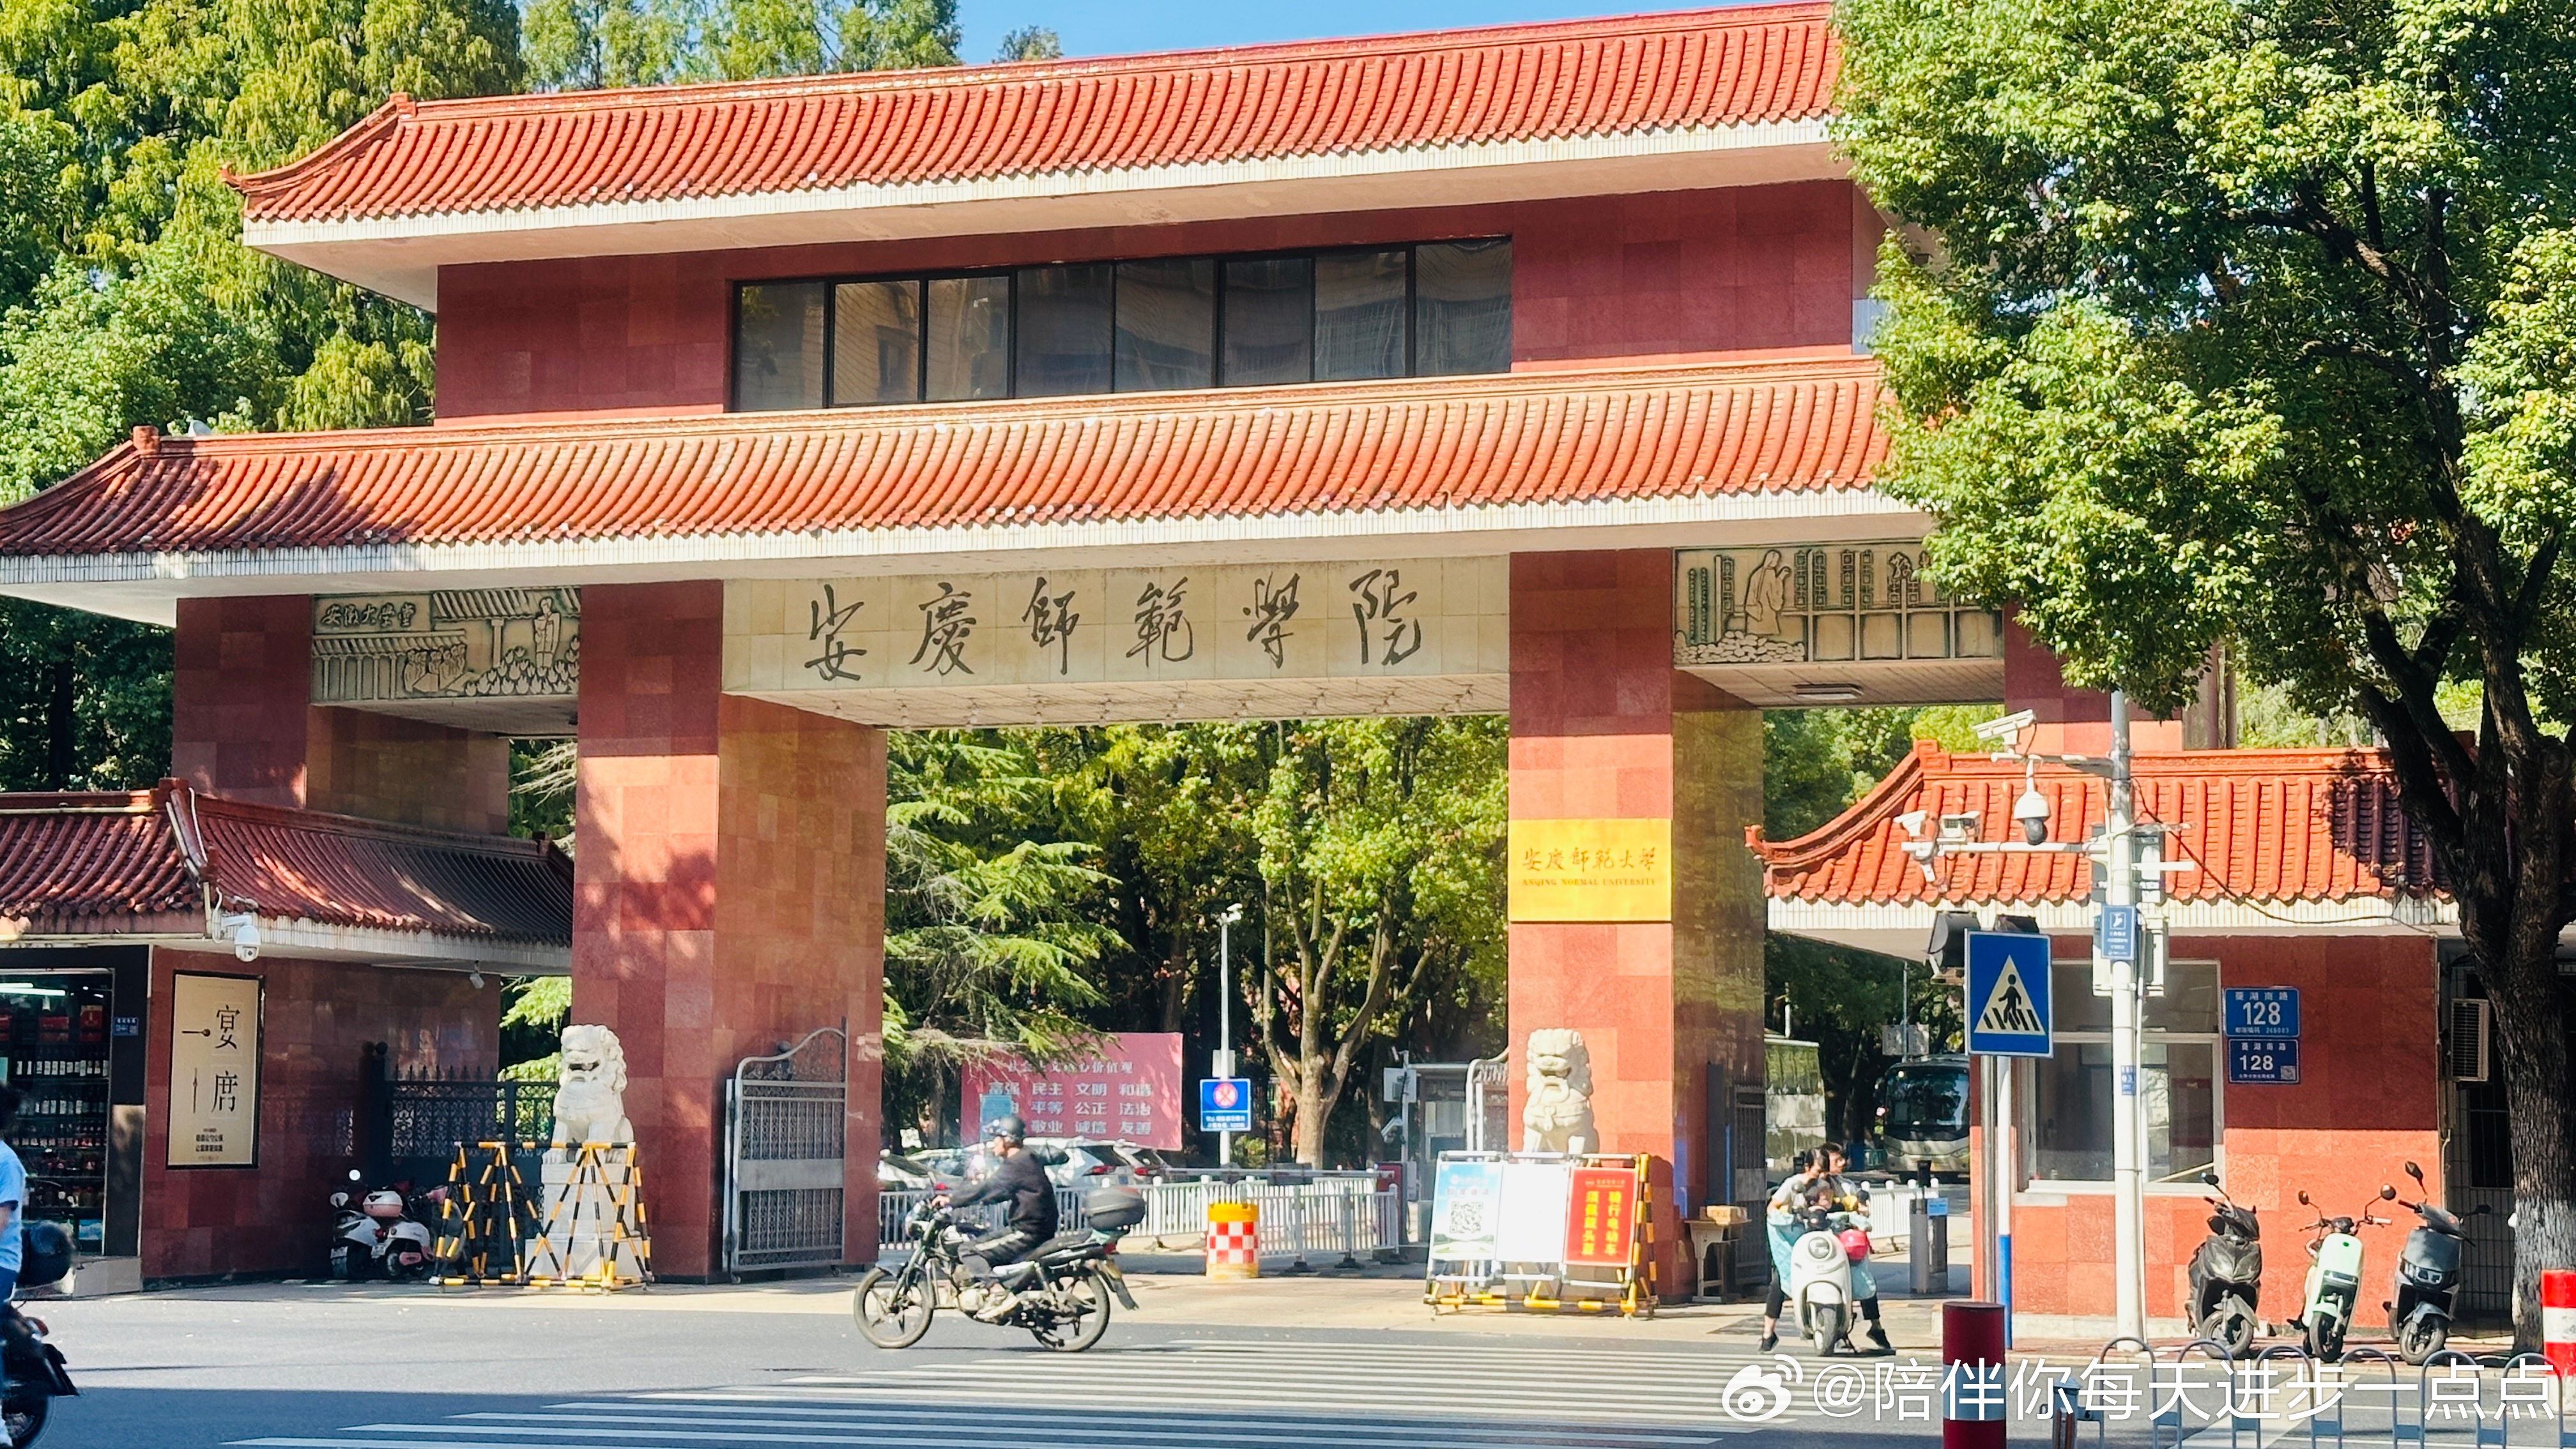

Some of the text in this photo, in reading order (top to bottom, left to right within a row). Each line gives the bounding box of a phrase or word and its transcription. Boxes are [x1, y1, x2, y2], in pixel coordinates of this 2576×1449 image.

[1522, 878, 1557, 887] ANQING
[1603, 878, 1655, 886] UNIVERSITY
[2242, 1002, 2281, 1025] 128
[2239, 1055, 2274, 1070] 128
[988, 1082, 1152, 1097] 富强 民主 文明 和谐
[1031, 1102, 1064, 1115] 平等
[1075, 1102, 1107, 1115] 公正
[1119, 1102, 1151, 1116] 法治
[1031, 1120, 1152, 1135] 敬业 诚信 友善
